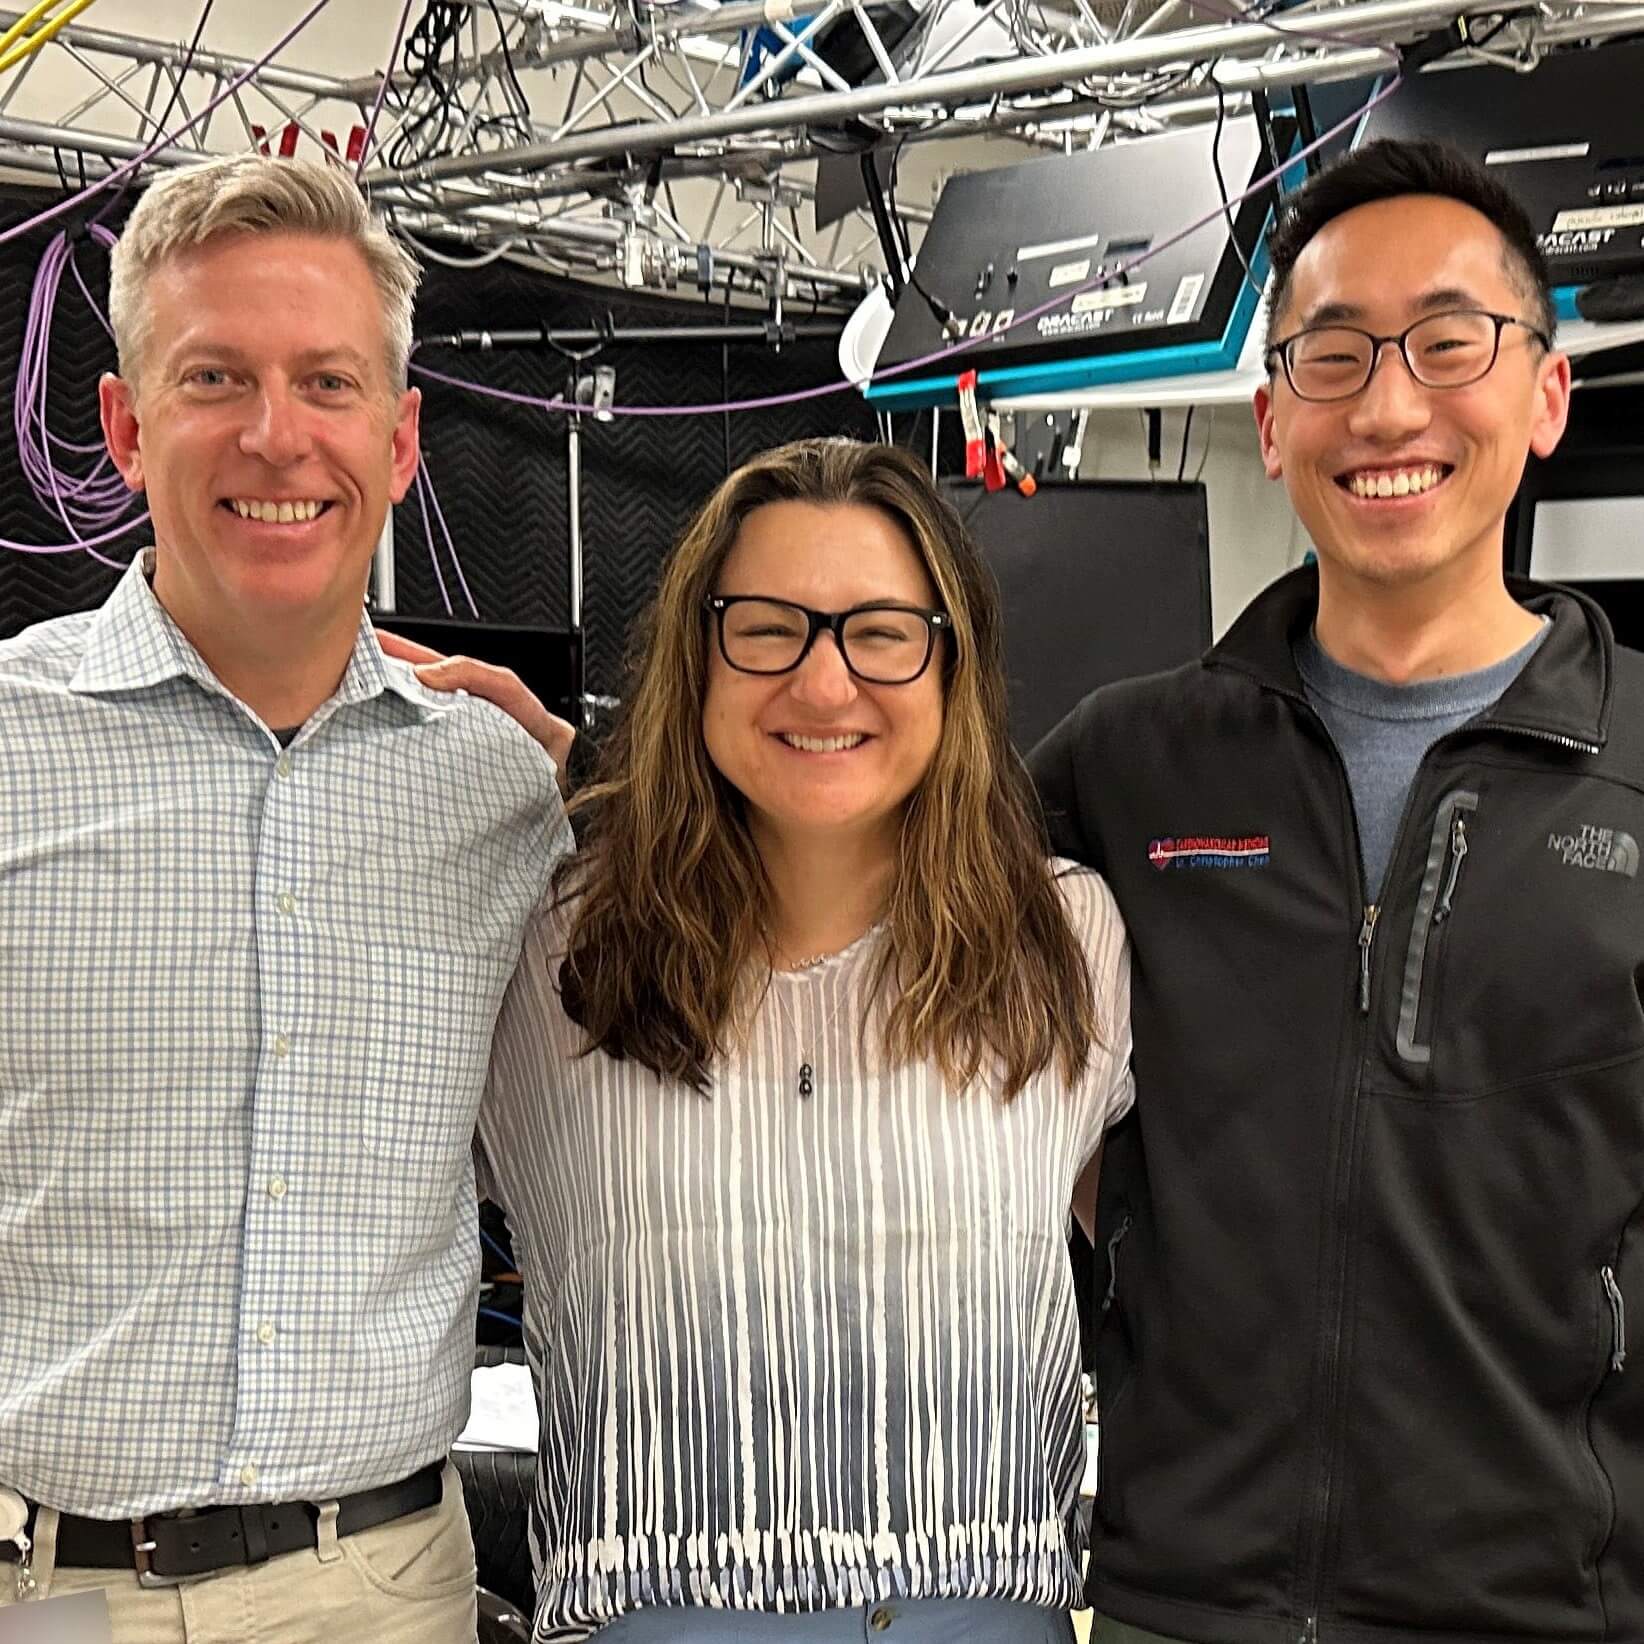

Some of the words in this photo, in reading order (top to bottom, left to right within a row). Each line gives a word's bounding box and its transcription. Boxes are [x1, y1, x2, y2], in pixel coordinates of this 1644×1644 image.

[1547, 832, 1612, 857] NORTH
[1581, 824, 1614, 842] THE
[1562, 848, 1608, 871] FACE
